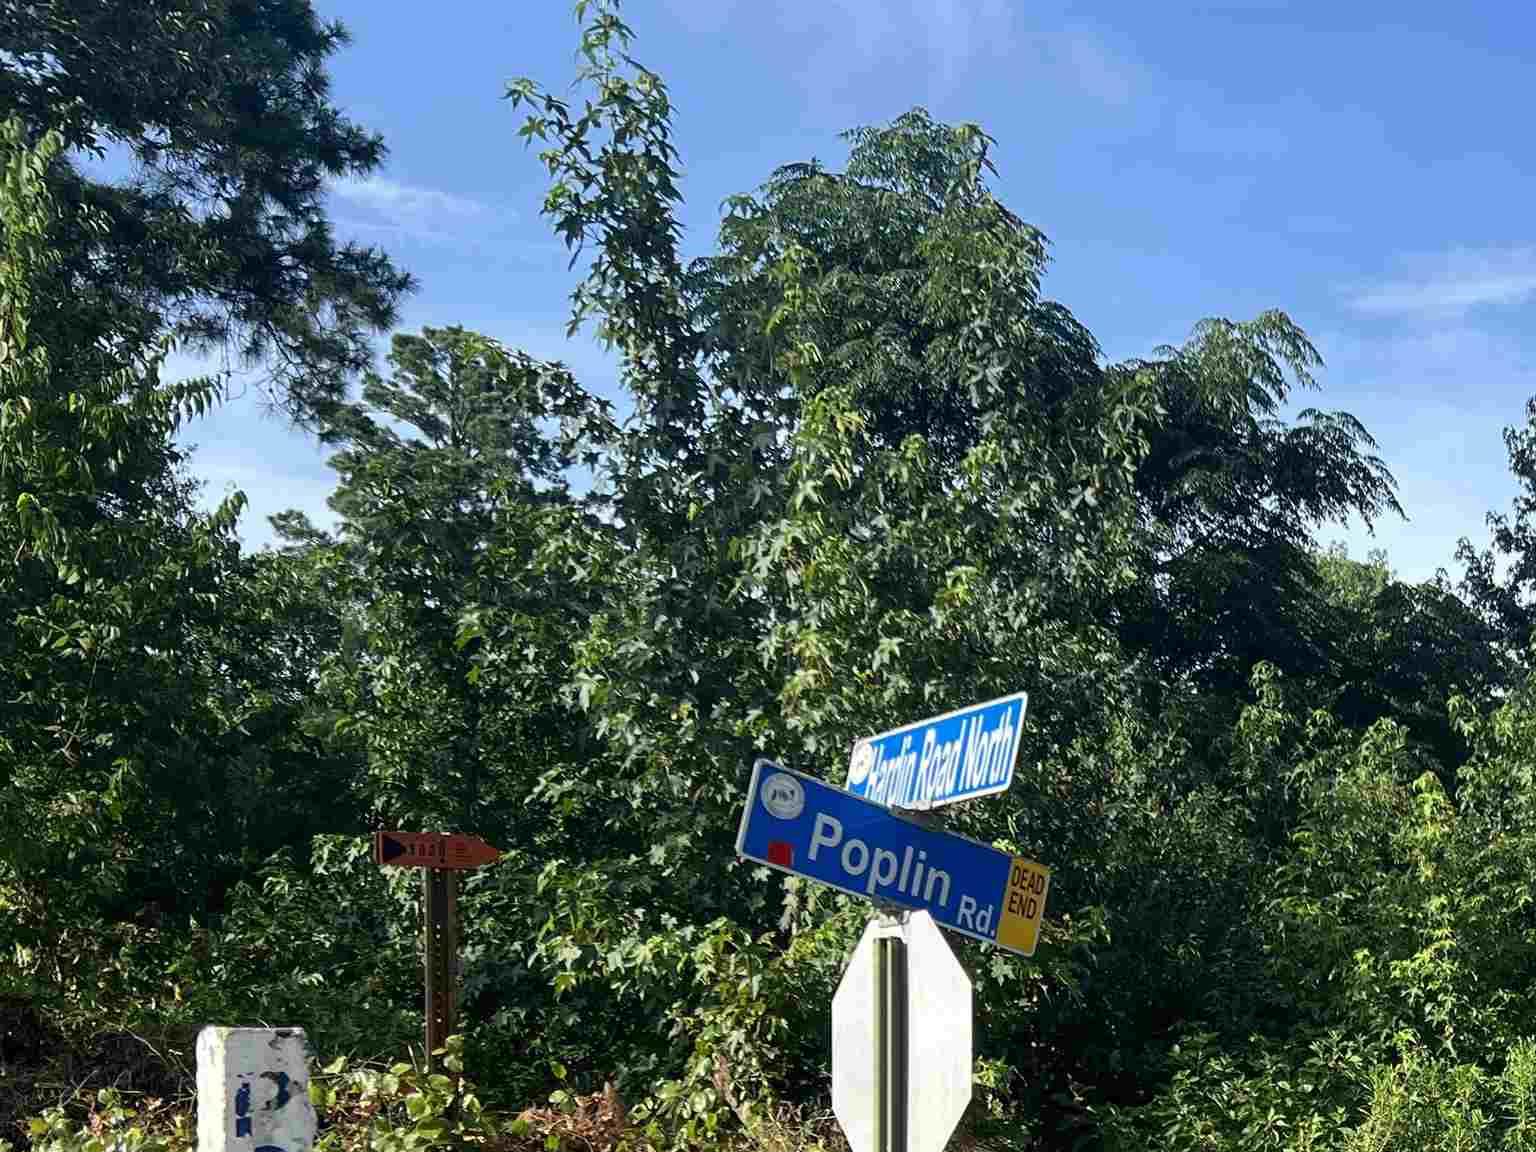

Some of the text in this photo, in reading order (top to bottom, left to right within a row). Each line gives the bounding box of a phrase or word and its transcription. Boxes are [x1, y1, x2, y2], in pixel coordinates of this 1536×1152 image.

[864, 706, 1015, 804] Hardin Road North
[807, 812, 951, 907] Poplin
[1010, 865, 1046, 895] DEAD
[1007, 893, 1038, 920] END
